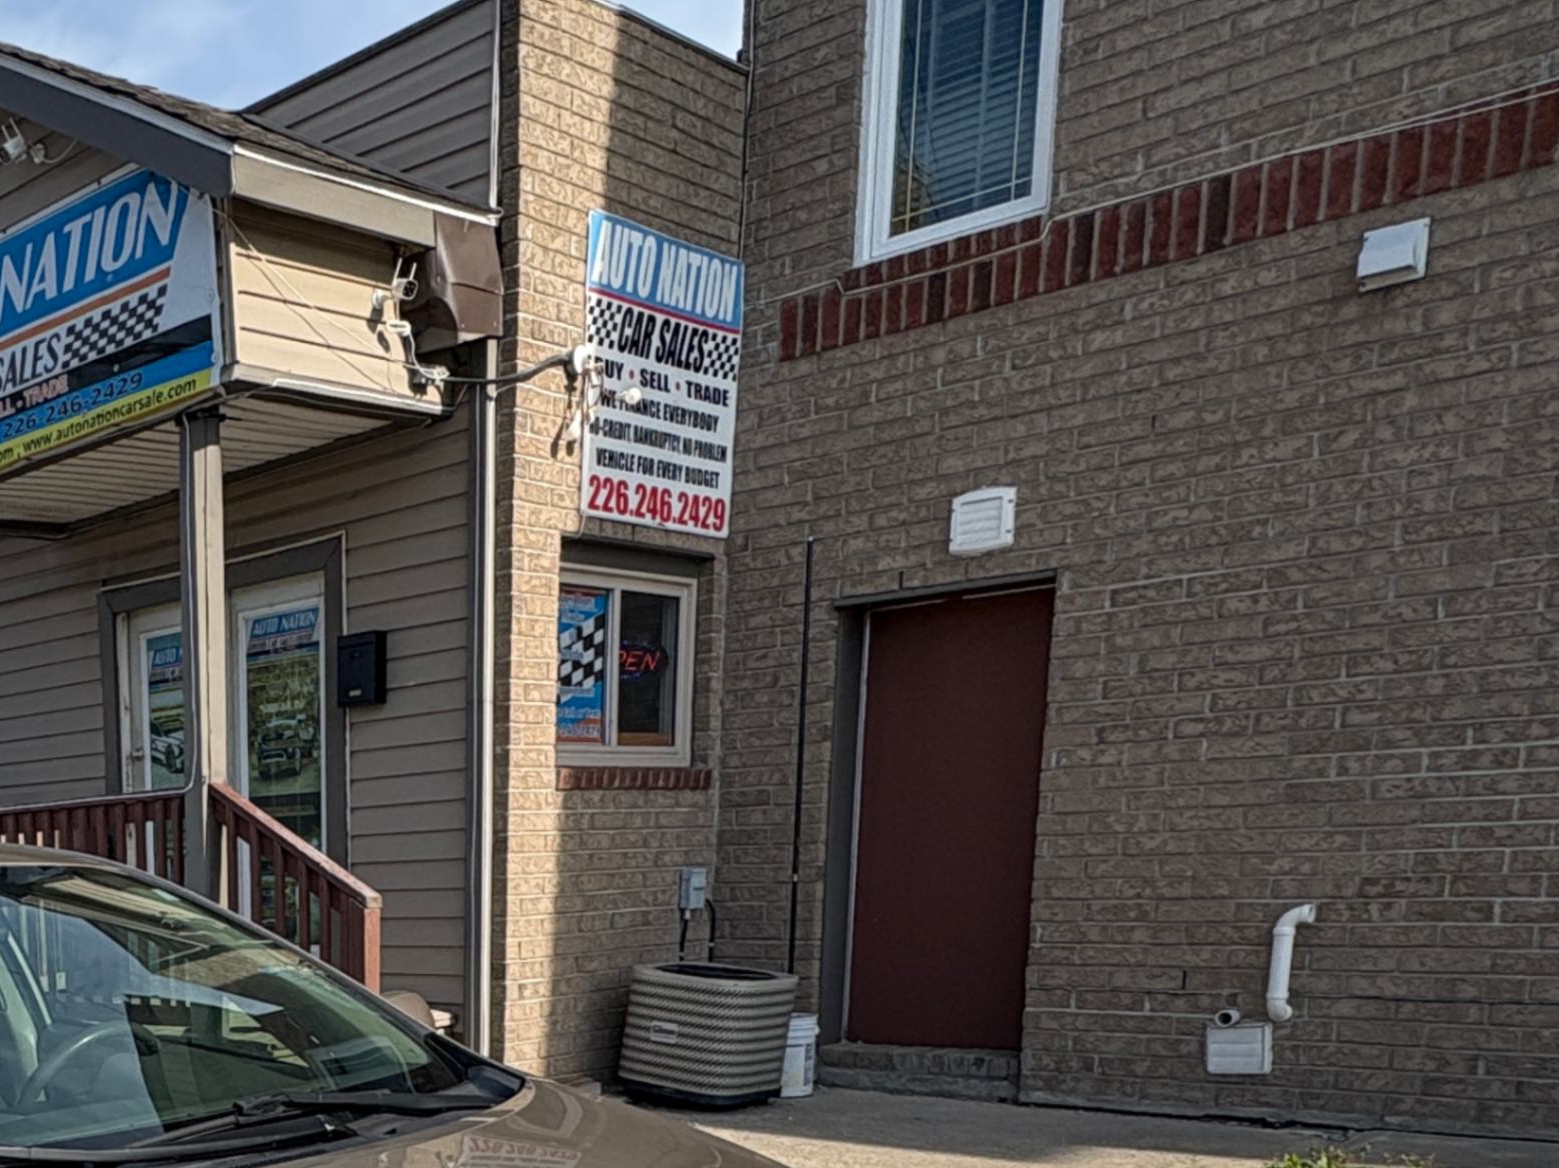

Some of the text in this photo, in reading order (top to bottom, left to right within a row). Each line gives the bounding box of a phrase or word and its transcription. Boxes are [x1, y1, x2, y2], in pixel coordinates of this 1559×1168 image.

[592, 220, 738, 323] AUTO NATION
[617, 305, 709, 373] CAR SALES
[23, 374, 69, 408] TRADE
[594, 356, 730, 407] UY SELL TRADE
[22, 378, 197, 454] www.autonationcarsale.com
[663, 403, 720, 433] EVERYBODY
[596, 448, 721, 489] VEHICLE FOR EVERY BUDGET
[694, 439, 728, 463] PROBLEM
[587, 475, 726, 532] 226.246.2429
